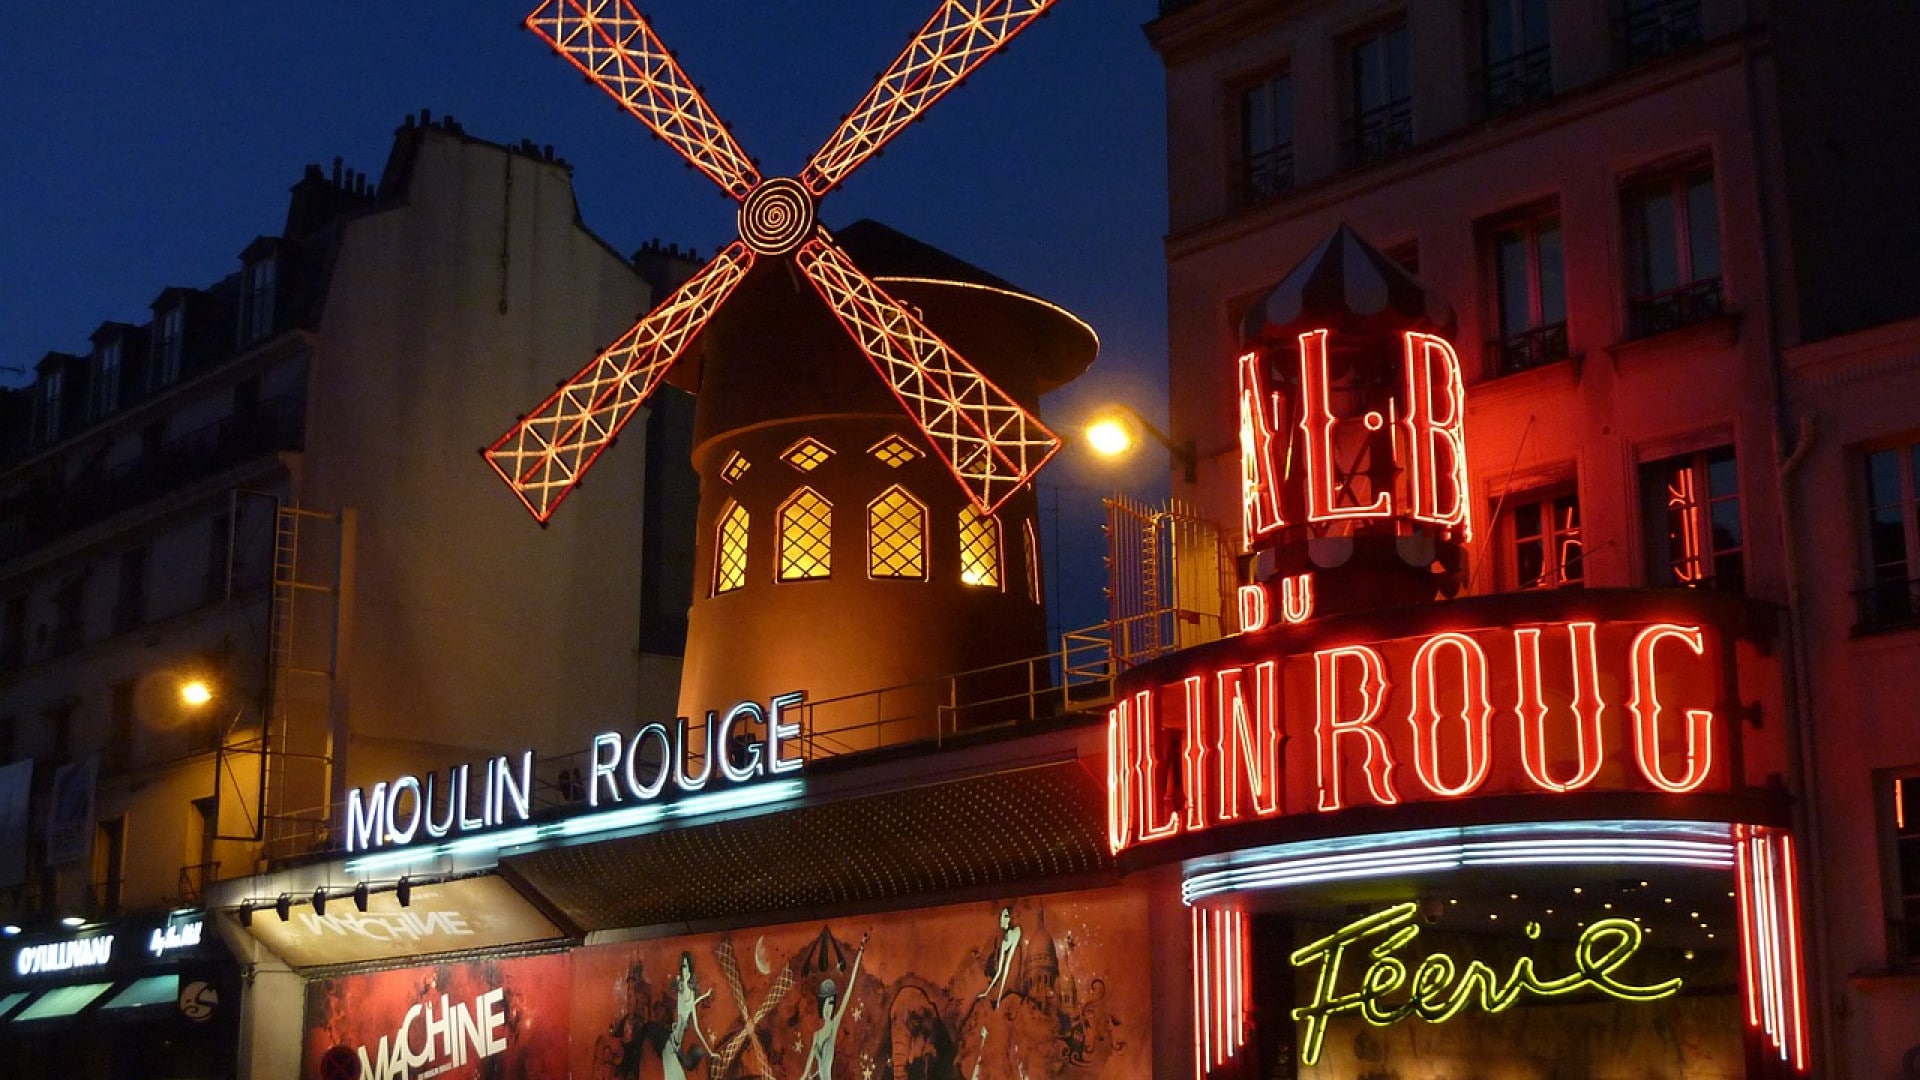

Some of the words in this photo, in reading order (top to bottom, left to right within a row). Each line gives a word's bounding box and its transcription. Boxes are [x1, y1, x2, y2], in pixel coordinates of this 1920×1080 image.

[1238, 574, 1313, 632] DU
[345, 750, 536, 853] MOULIN
[589, 691, 806, 807] ROUGE
[356, 986, 508, 1080] MACHINE
[1290, 901, 1682, 1066] Féerie
